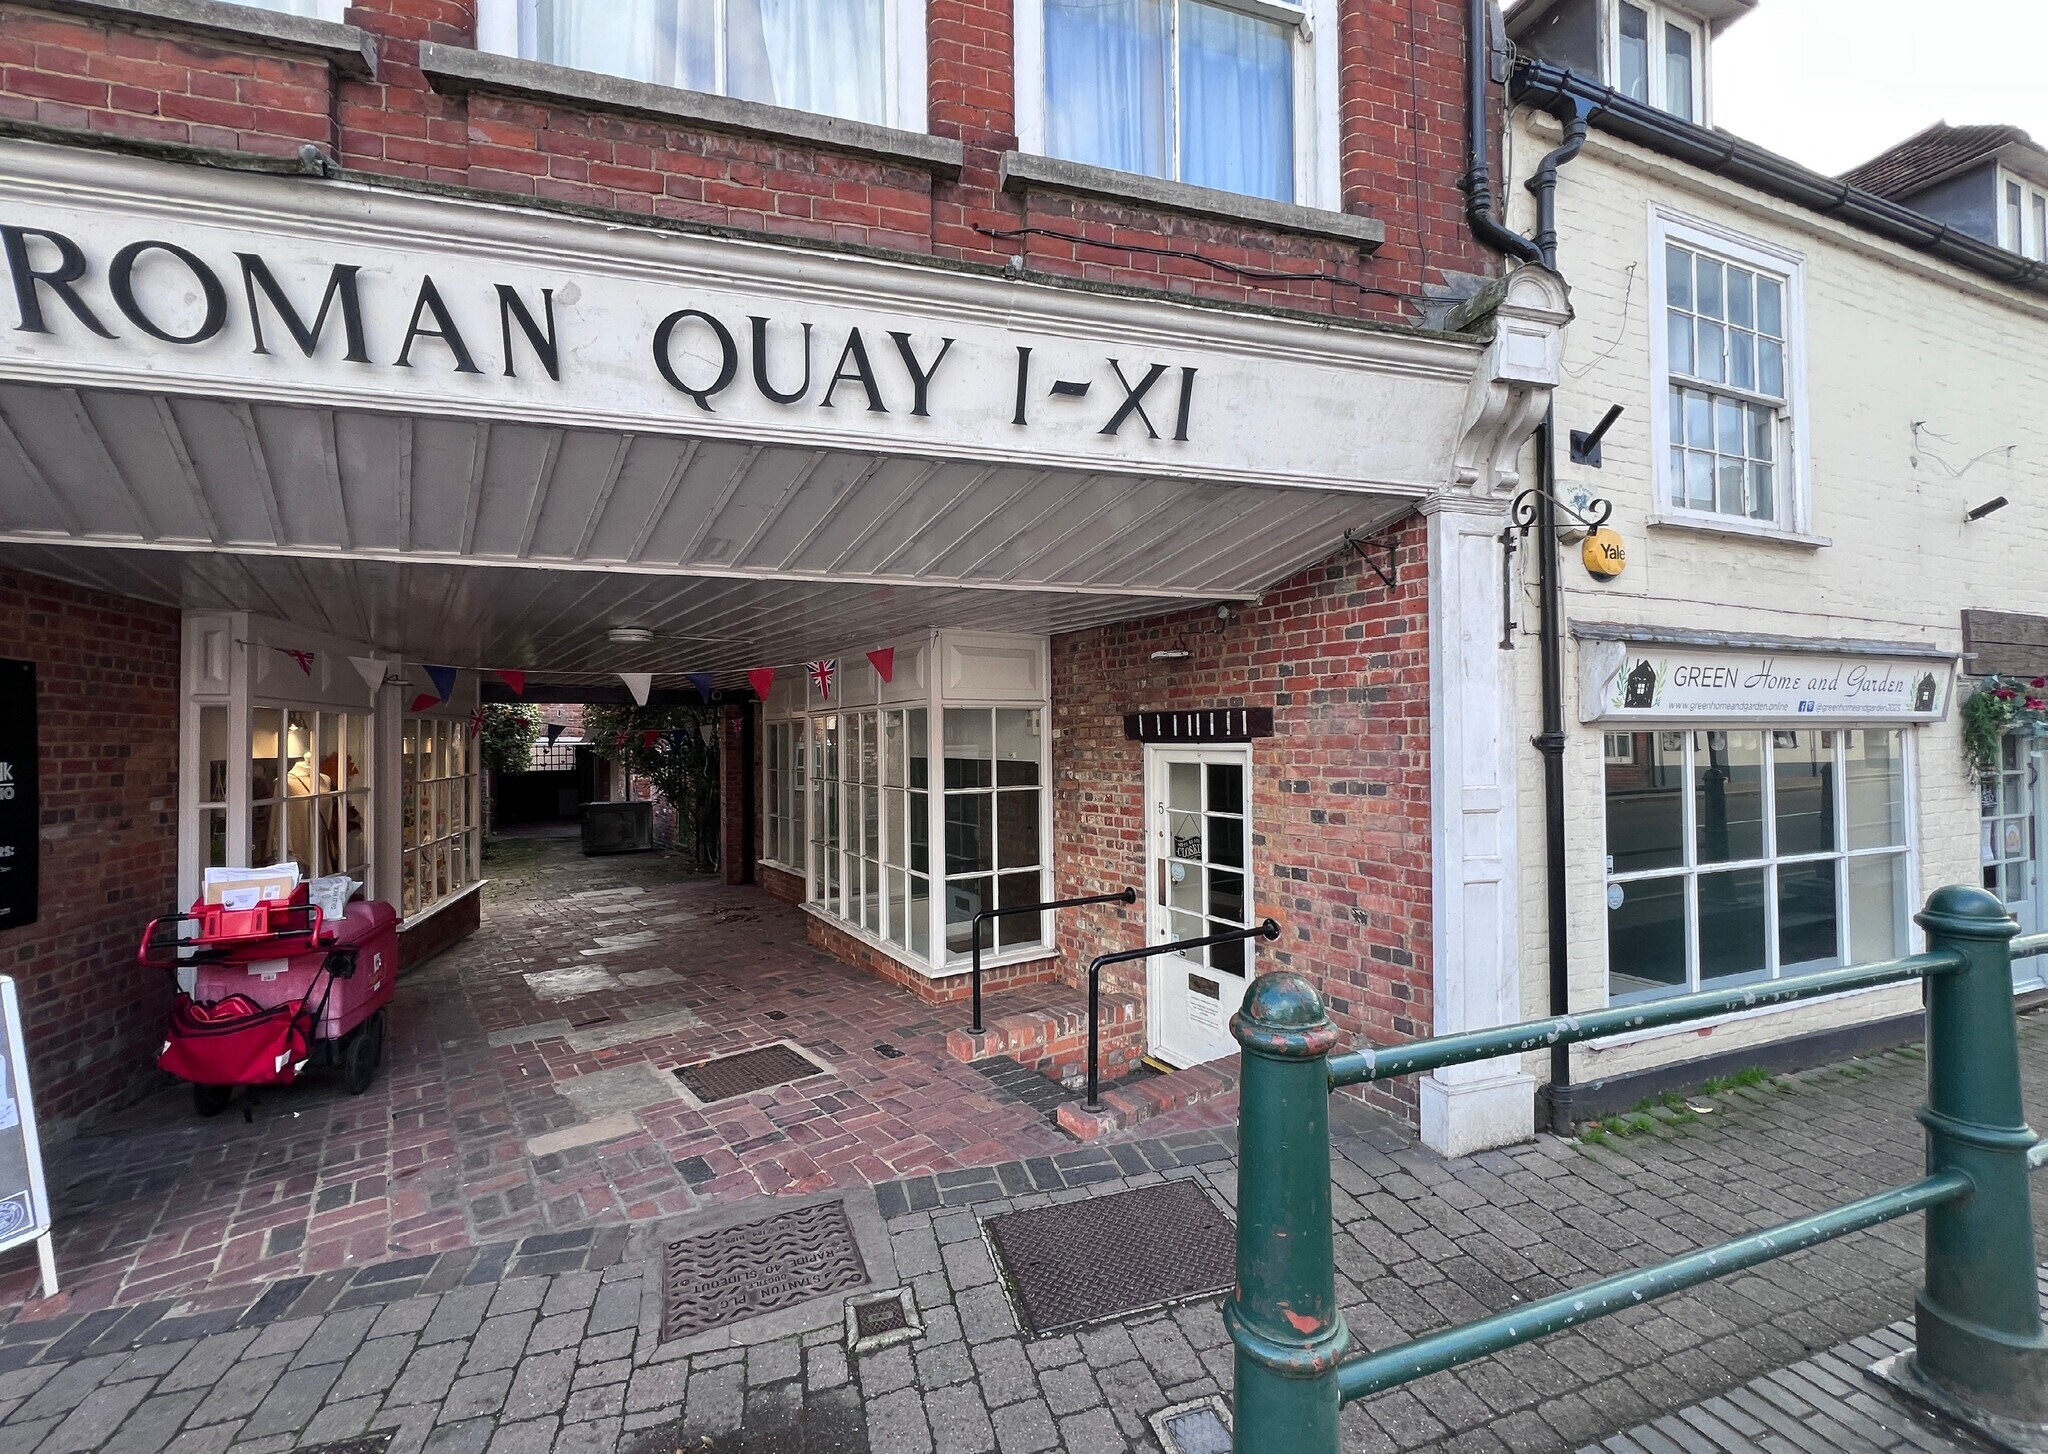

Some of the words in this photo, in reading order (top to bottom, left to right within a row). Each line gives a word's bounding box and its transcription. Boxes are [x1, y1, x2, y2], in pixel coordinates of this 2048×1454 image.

[0, 225, 560, 382] ROMAN
[652, 308, 956, 417] QUAY
[1600, 543, 1626, 561] Yale
[1674, 665, 1739, 689] GREEN
[1744, 657, 1801, 690] Home
[1807, 663, 1843, 691] and
[1844, 664, 1904, 698] Garden
[1668, 701, 1789, 712] www.greenhomeandgarden.online
[1158, 801, 1165, 815] 5
[790, 1249, 835, 1268] RAPIDE
[766, 1264, 783, 1274] 40
[694, 1269, 757, 1294] SLIDEOUT
[761, 1274, 821, 1298] STANTON
[720, 1295, 746, 1309] PLC
